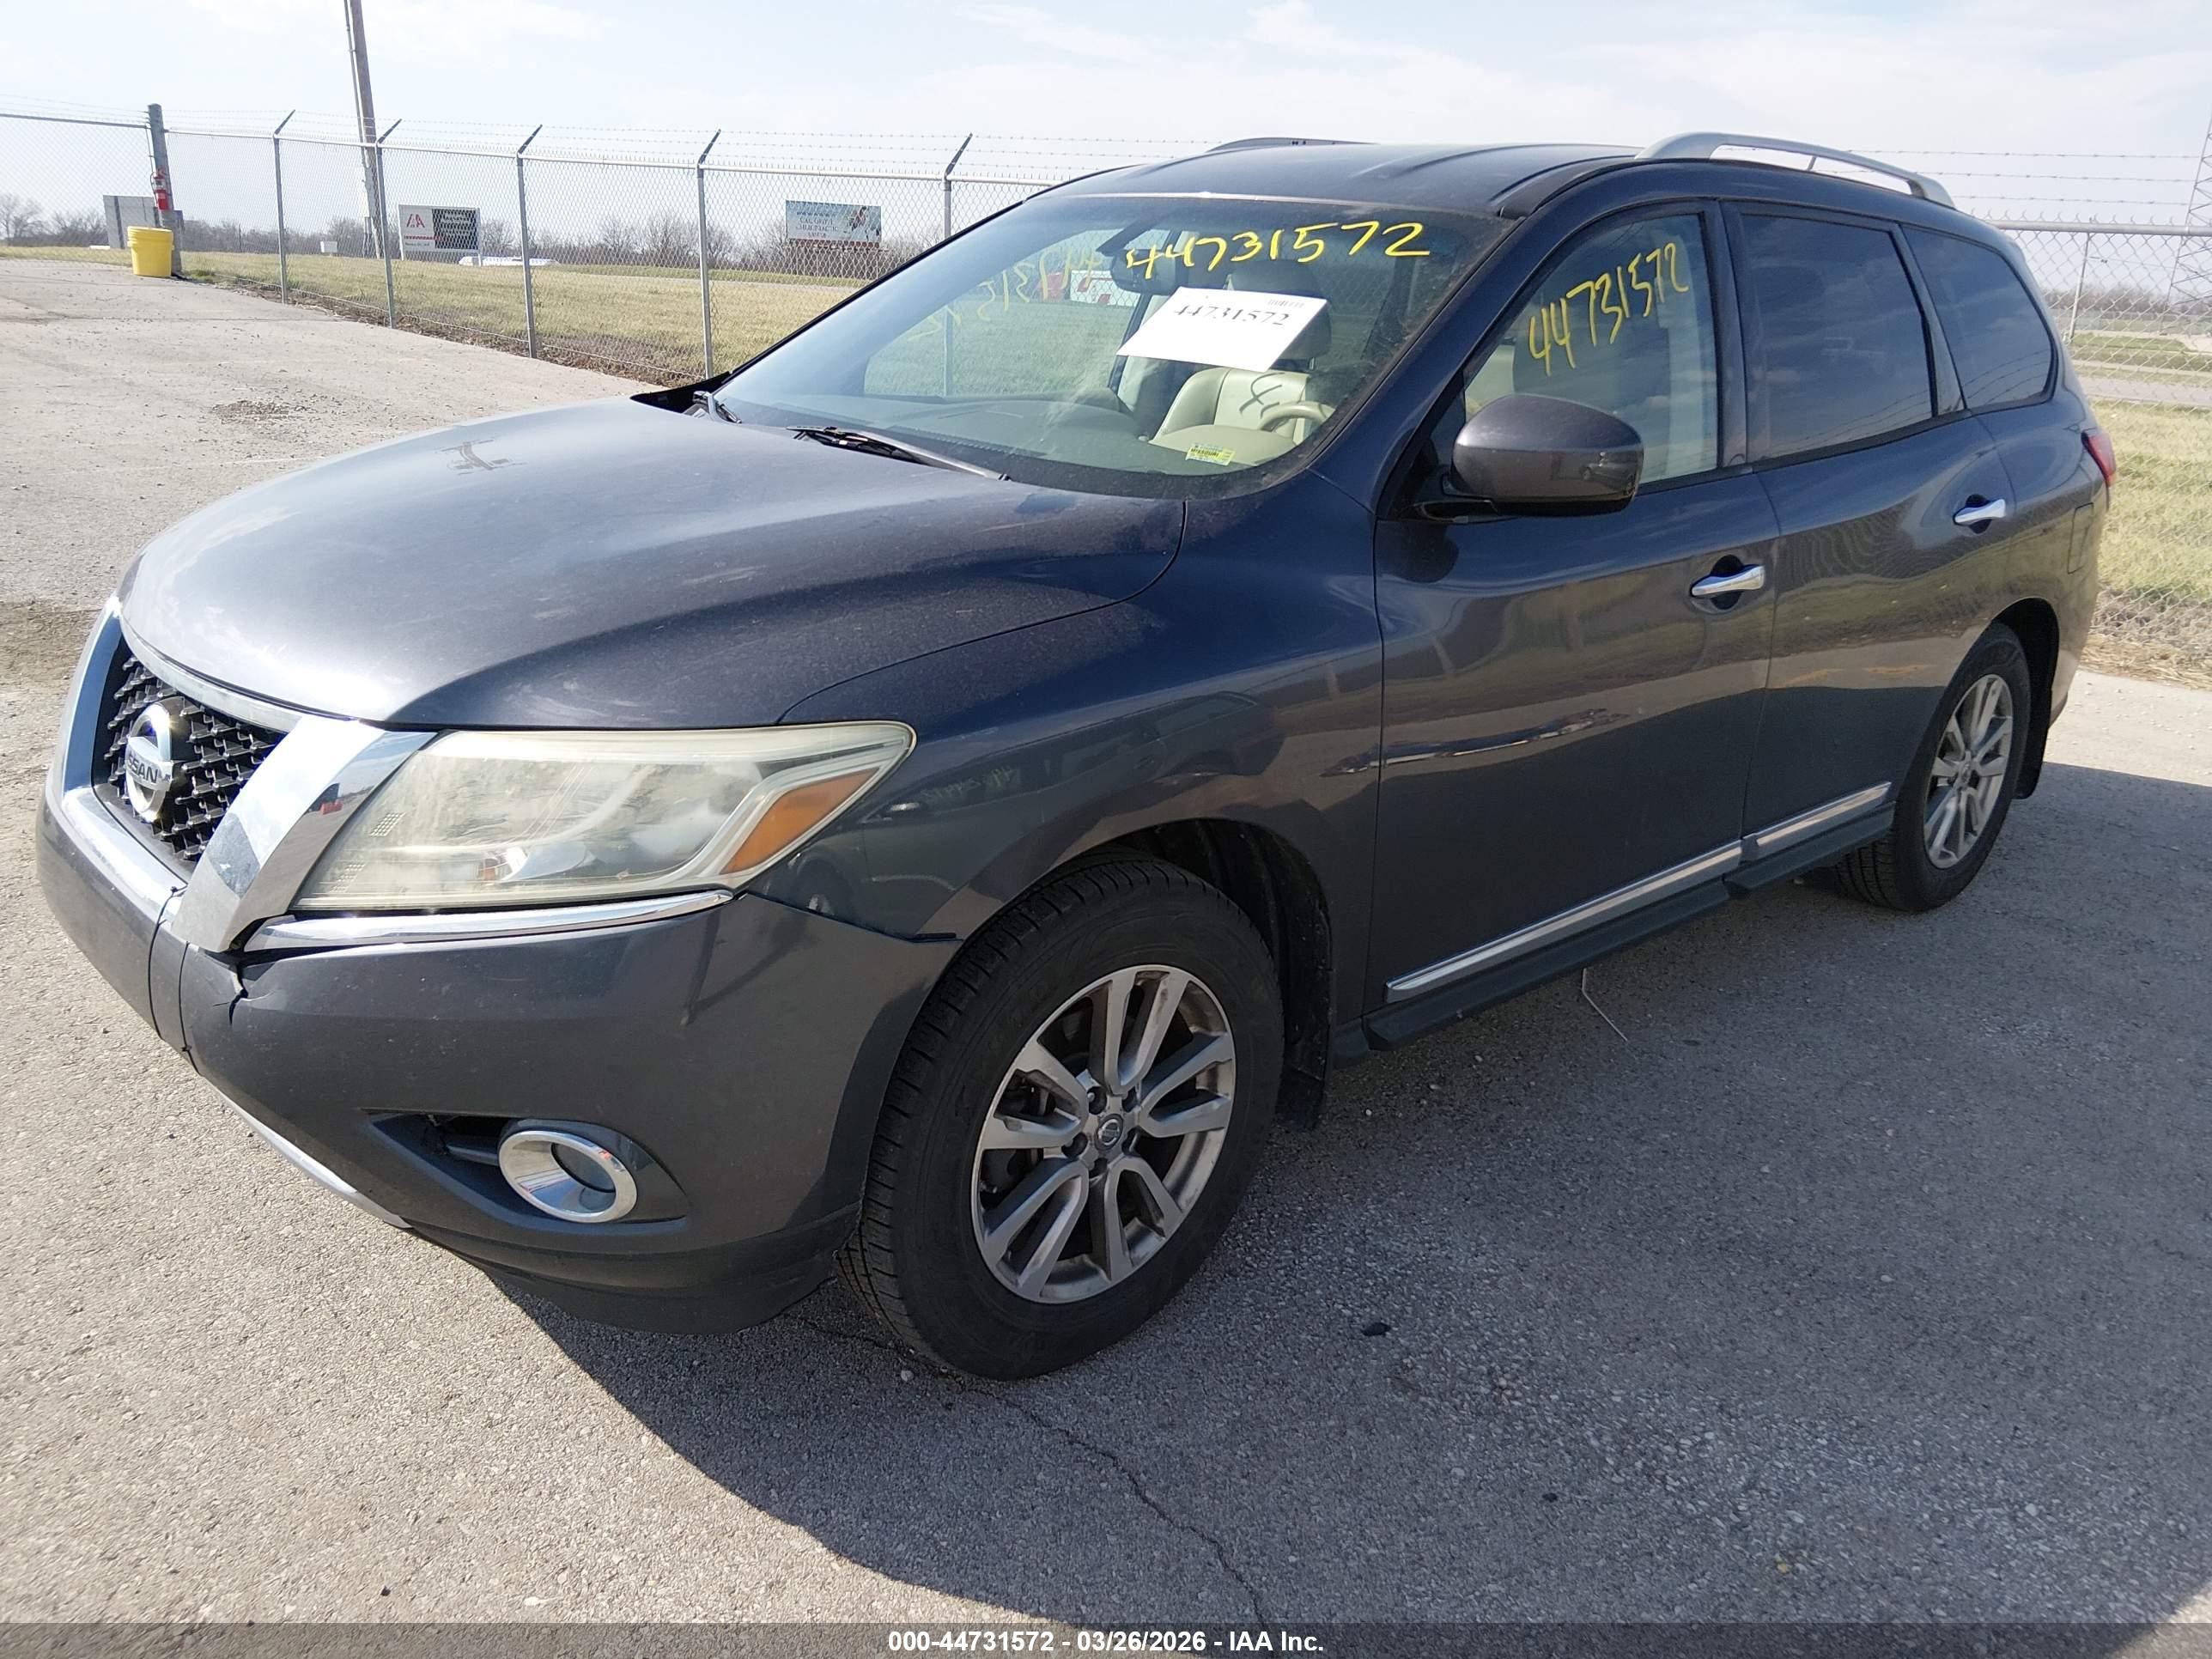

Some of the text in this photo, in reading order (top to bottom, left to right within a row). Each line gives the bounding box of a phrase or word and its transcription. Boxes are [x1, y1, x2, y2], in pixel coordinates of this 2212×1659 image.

[1126, 221, 1431, 280] 44731572
[1175, 305, 1289, 326] 44731572
[1528, 242, 1689, 376] 44731572
